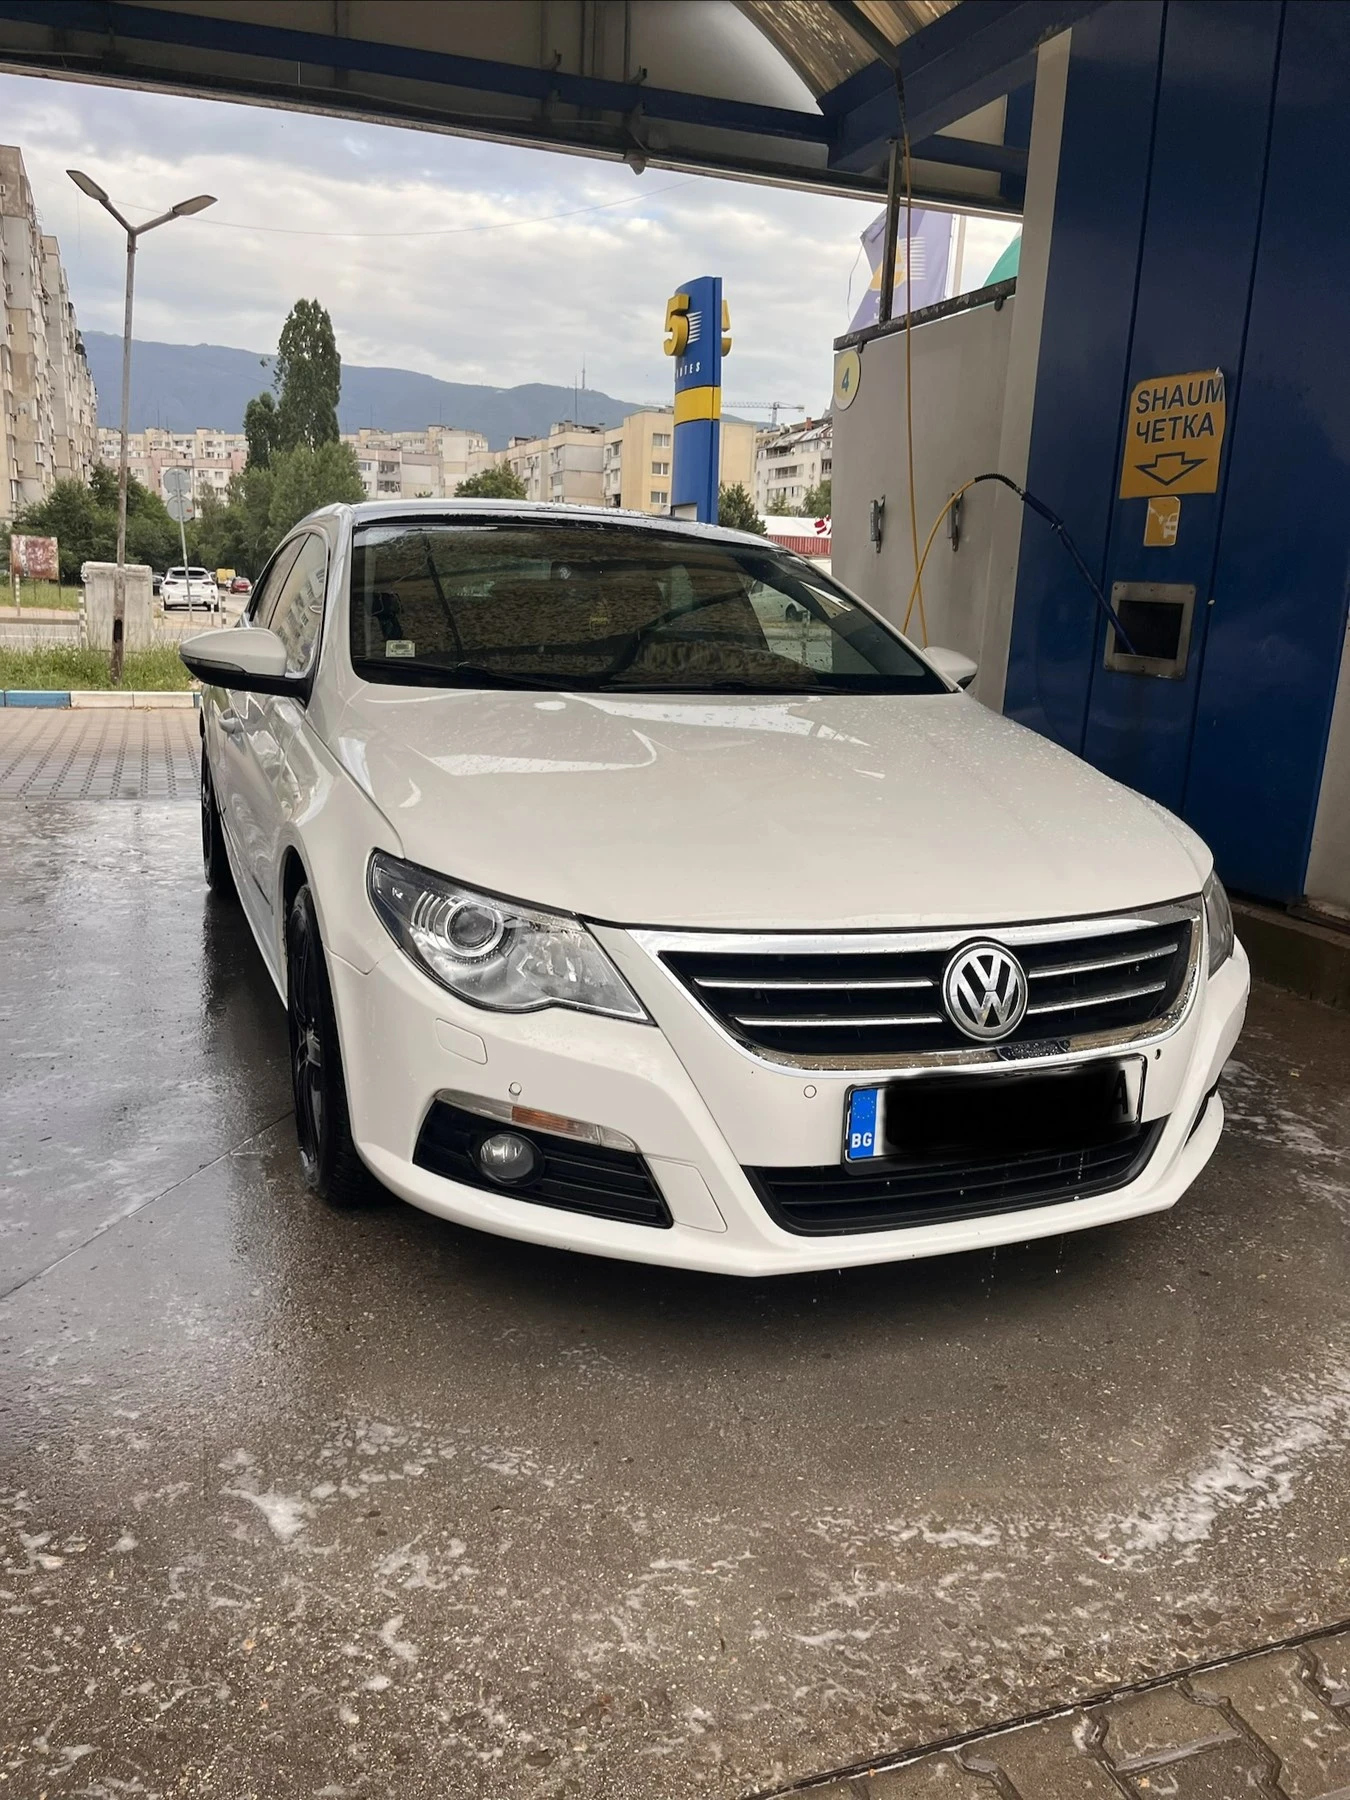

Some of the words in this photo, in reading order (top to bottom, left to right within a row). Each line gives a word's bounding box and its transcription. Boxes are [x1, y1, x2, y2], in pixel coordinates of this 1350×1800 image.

[841, 367, 850, 392] 4
[1136, 378, 1223, 415] SHAUM
[1136, 412, 1215, 444] ЧЕТКА
[851, 1132, 873, 1149] BG
